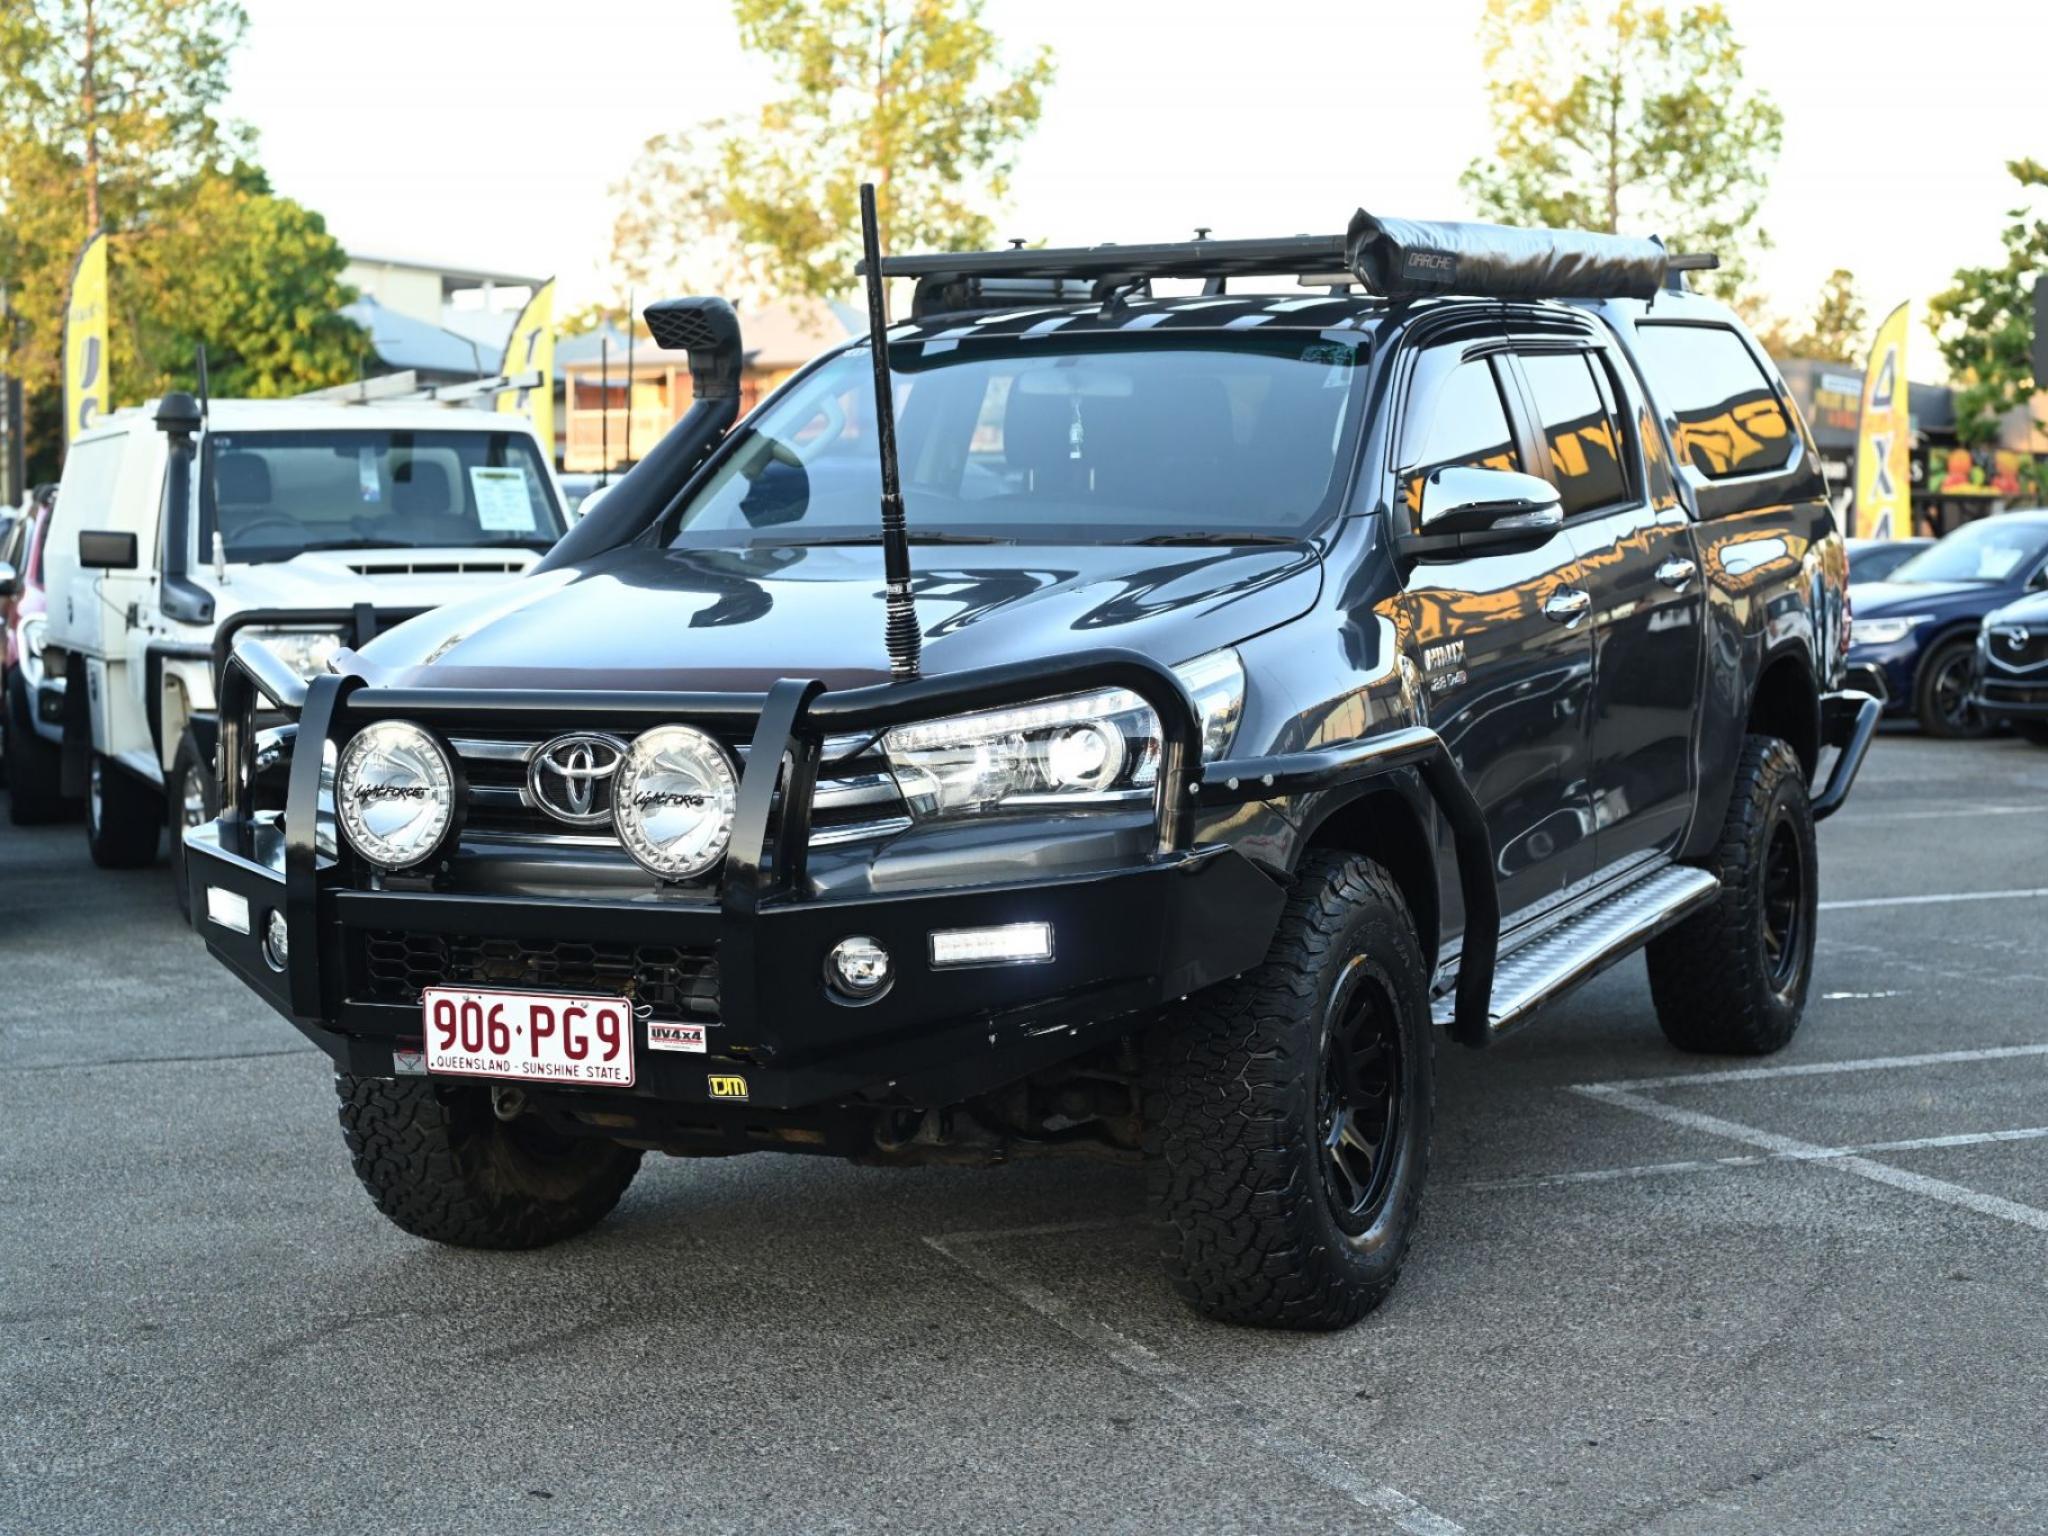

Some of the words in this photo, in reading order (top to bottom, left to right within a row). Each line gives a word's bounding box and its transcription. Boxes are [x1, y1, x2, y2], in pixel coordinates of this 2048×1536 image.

[1408, 252, 1454, 270] DARCHE
[437, 1055, 511, 1072] QUEENSLAND
[522, 1062, 580, 1077] SUNSHINE
[586, 1066, 621, 1080] STATE
